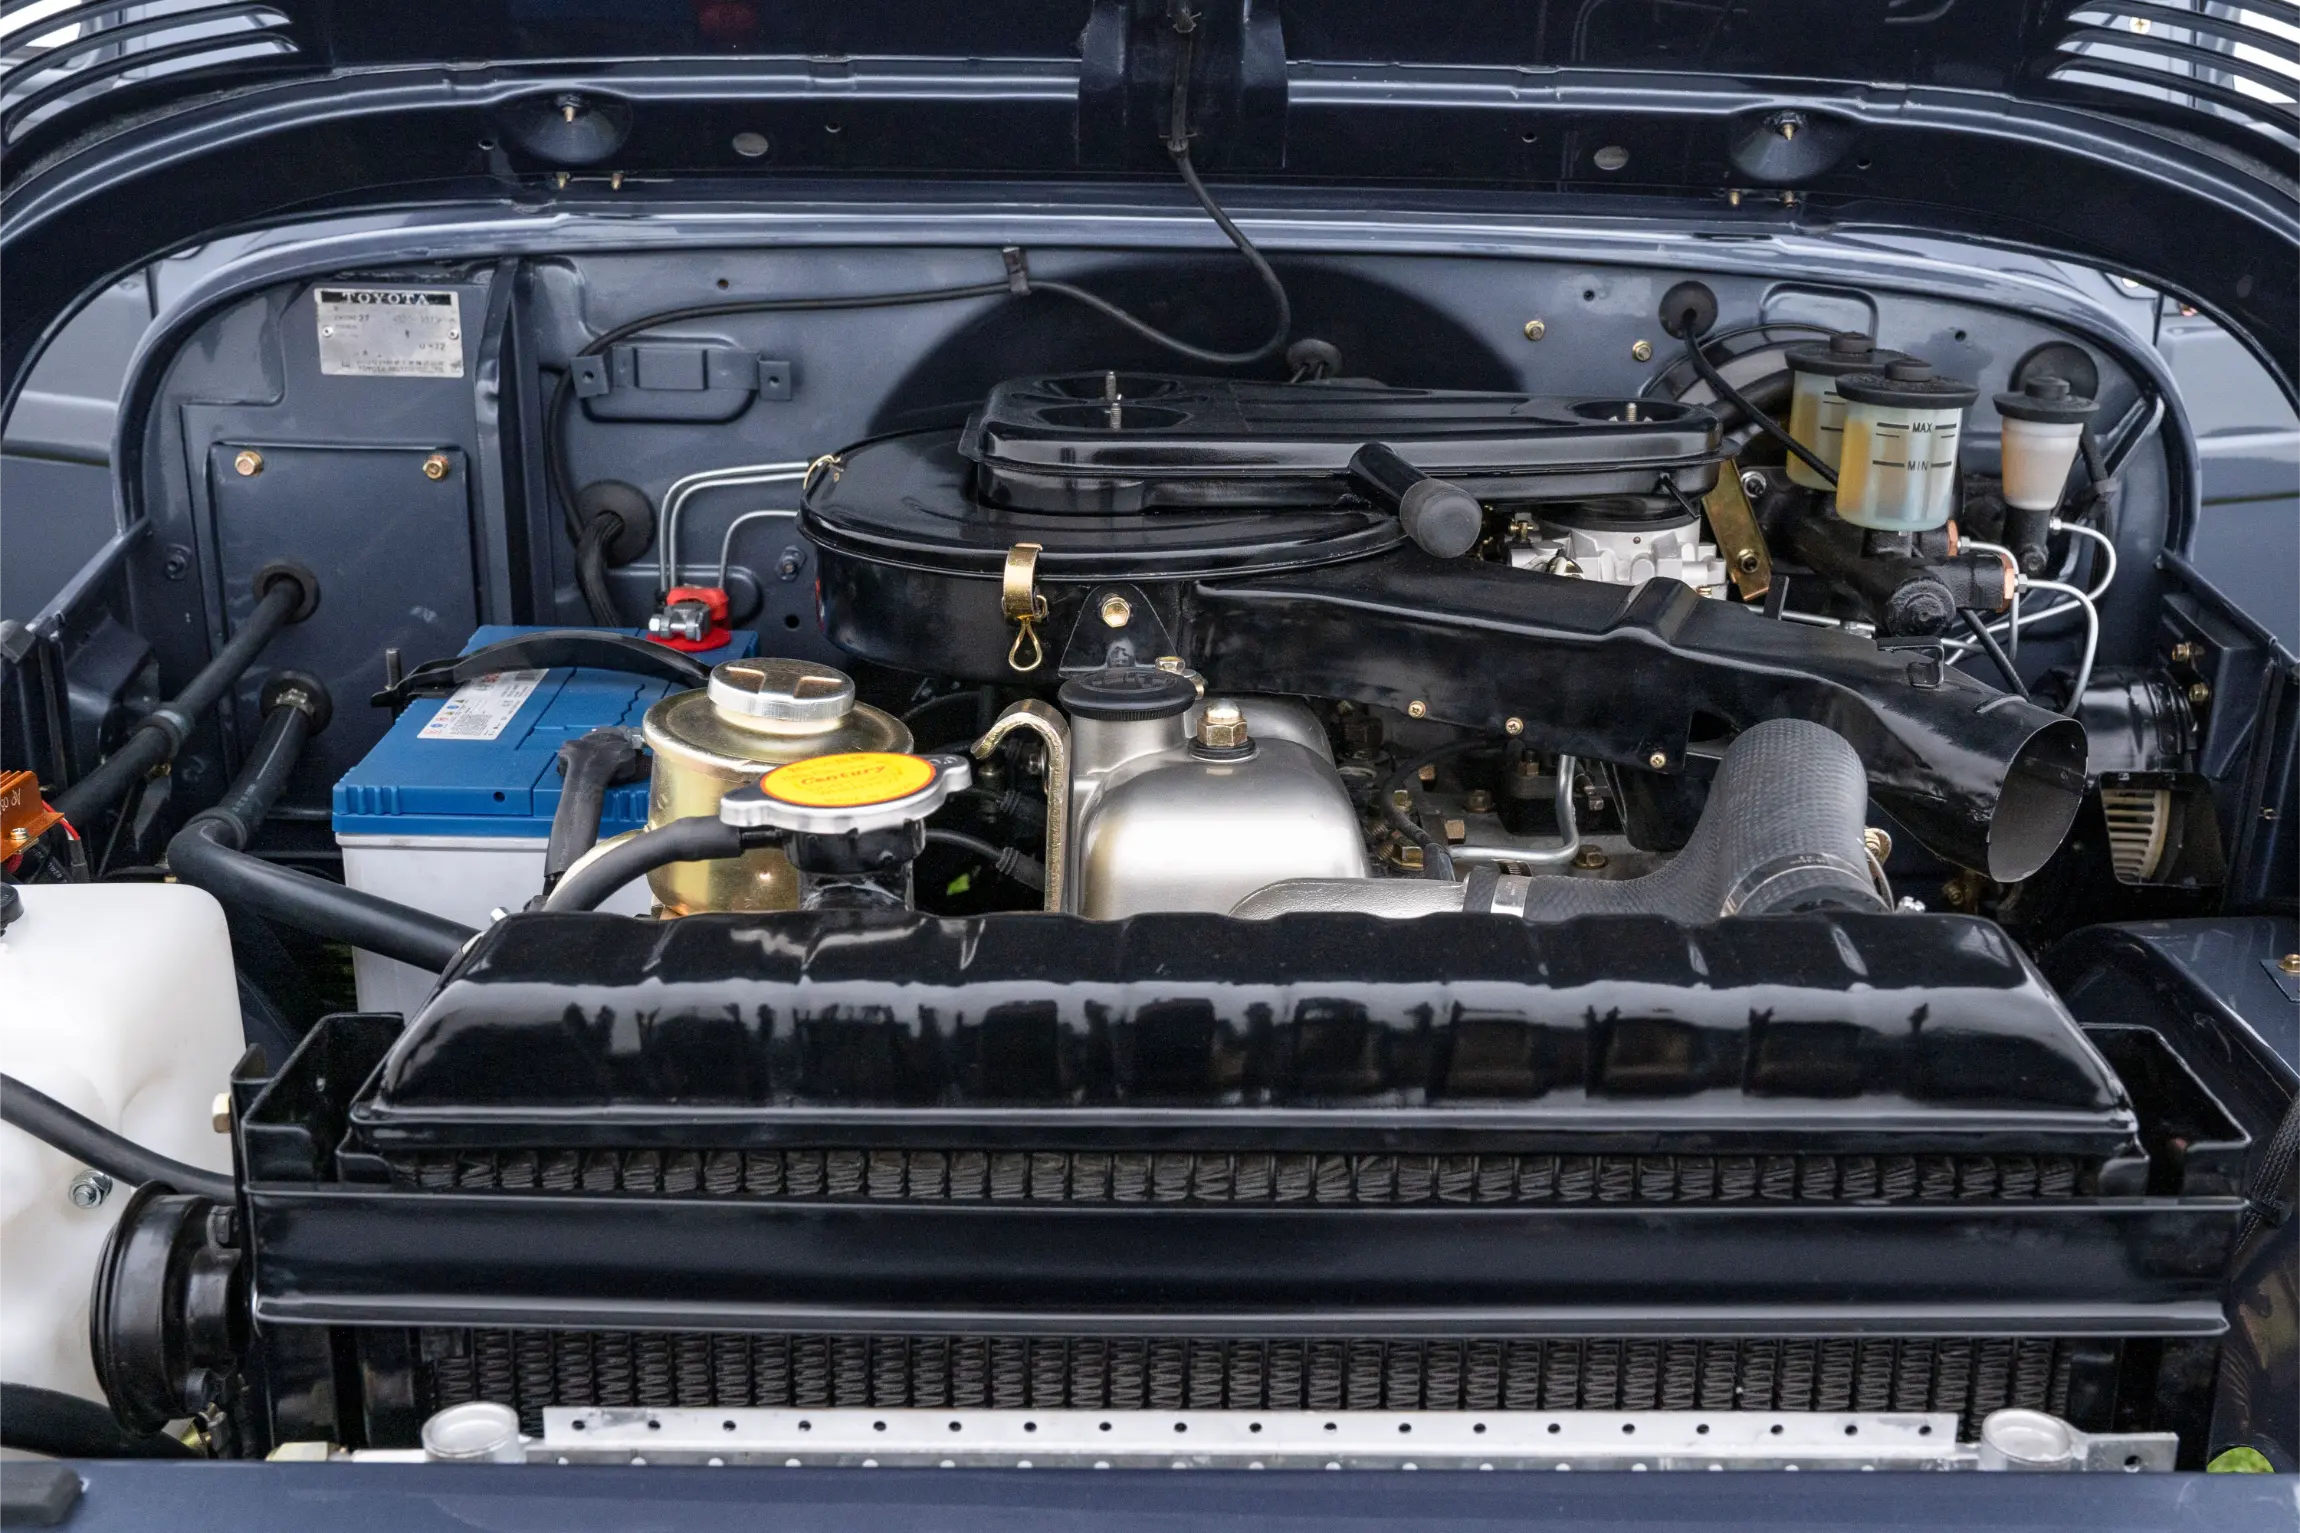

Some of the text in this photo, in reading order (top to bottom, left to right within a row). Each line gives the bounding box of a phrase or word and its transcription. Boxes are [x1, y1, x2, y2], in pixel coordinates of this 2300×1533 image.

[342, 292, 430, 305] TOYOTA
[1912, 422, 1933, 433] MAX
[1908, 460, 1928, 471] MIN
[801, 766, 885, 785] Century
